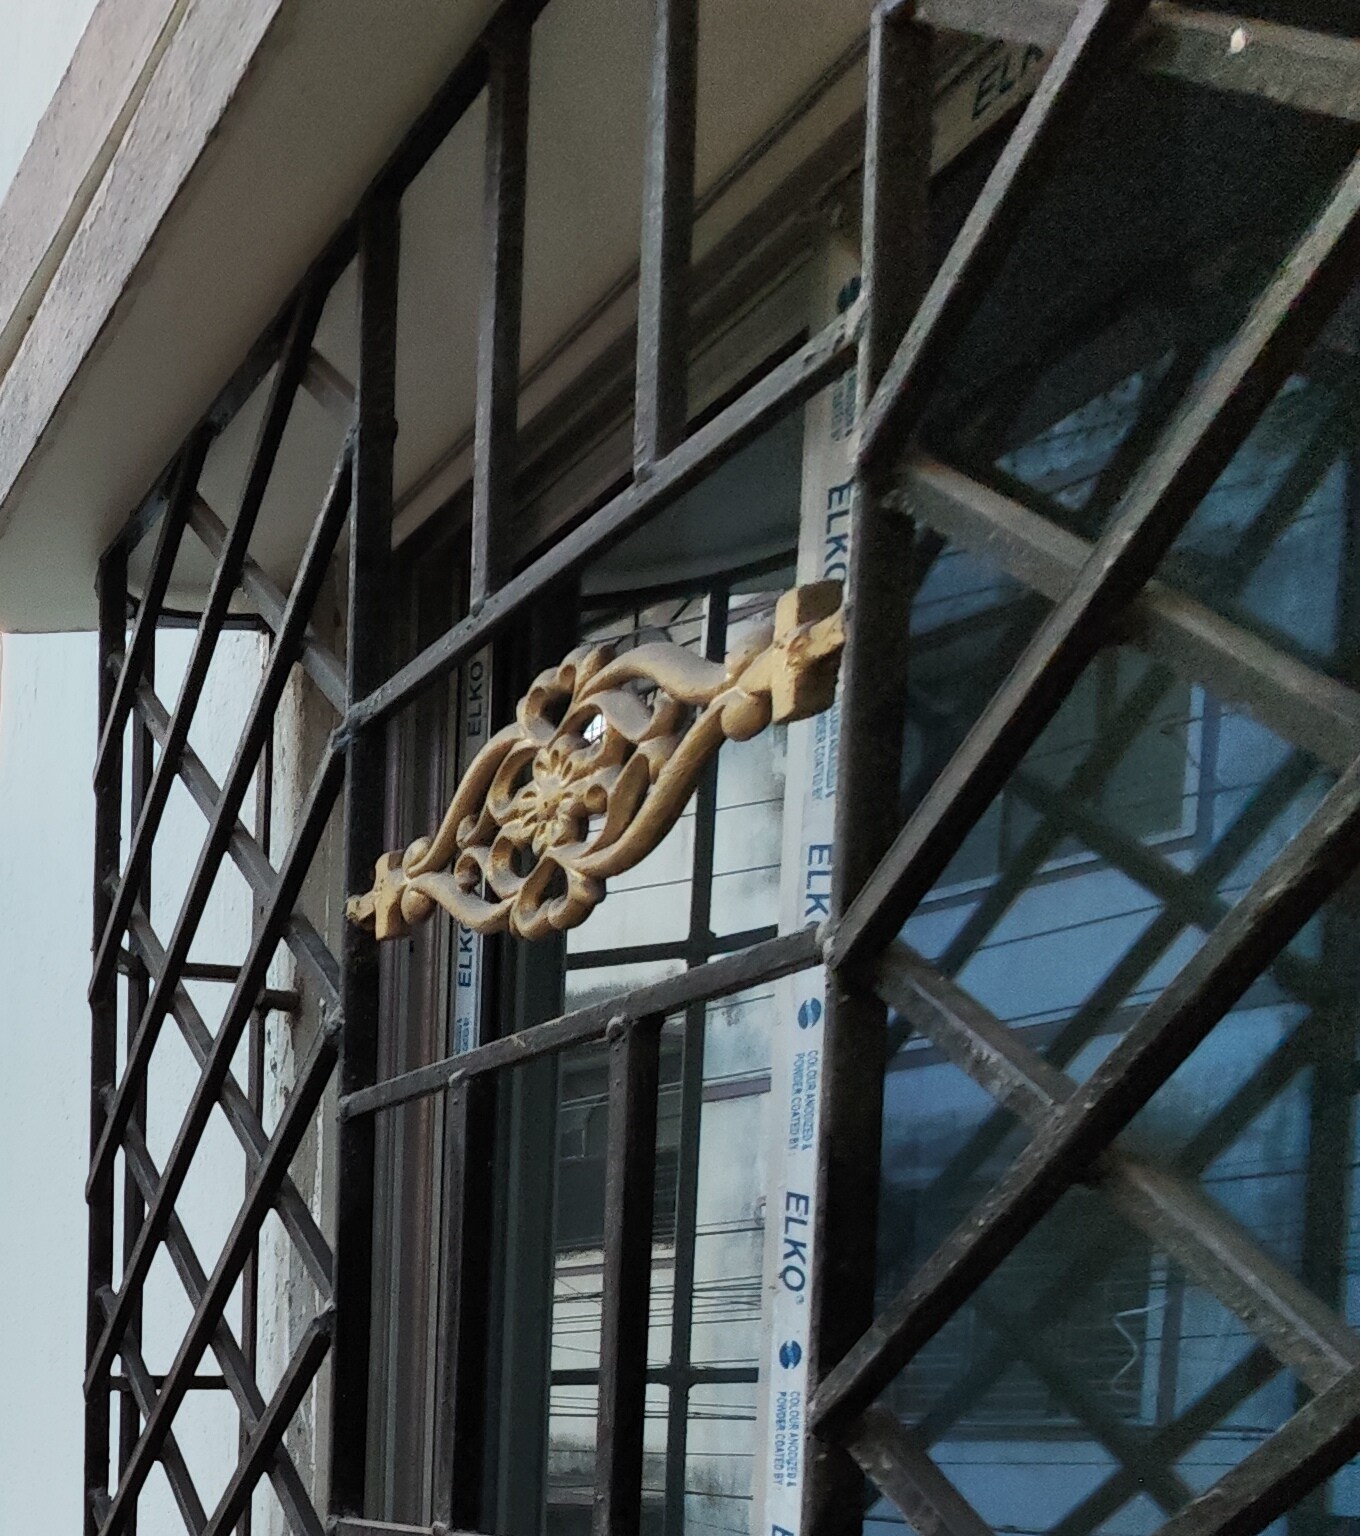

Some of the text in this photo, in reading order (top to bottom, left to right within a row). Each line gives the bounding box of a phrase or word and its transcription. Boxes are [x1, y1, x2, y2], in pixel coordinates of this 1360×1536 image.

[467, 661, 483, 737] ELKO
[804, 844, 832, 927] ELK
[792, 1052, 805, 1094] POWDER
[806, 1050, 818, 1091] COLOUR
[789, 1096, 802, 1135] COATED
[783, 1191, 810, 1292] ELKO
[775, 1391, 787, 1431] POWDER
[789, 1391, 801, 1430] COLOUR
[773, 1433, 786, 1471] COATED
[786, 1432, 799, 1479] ANODIZED
